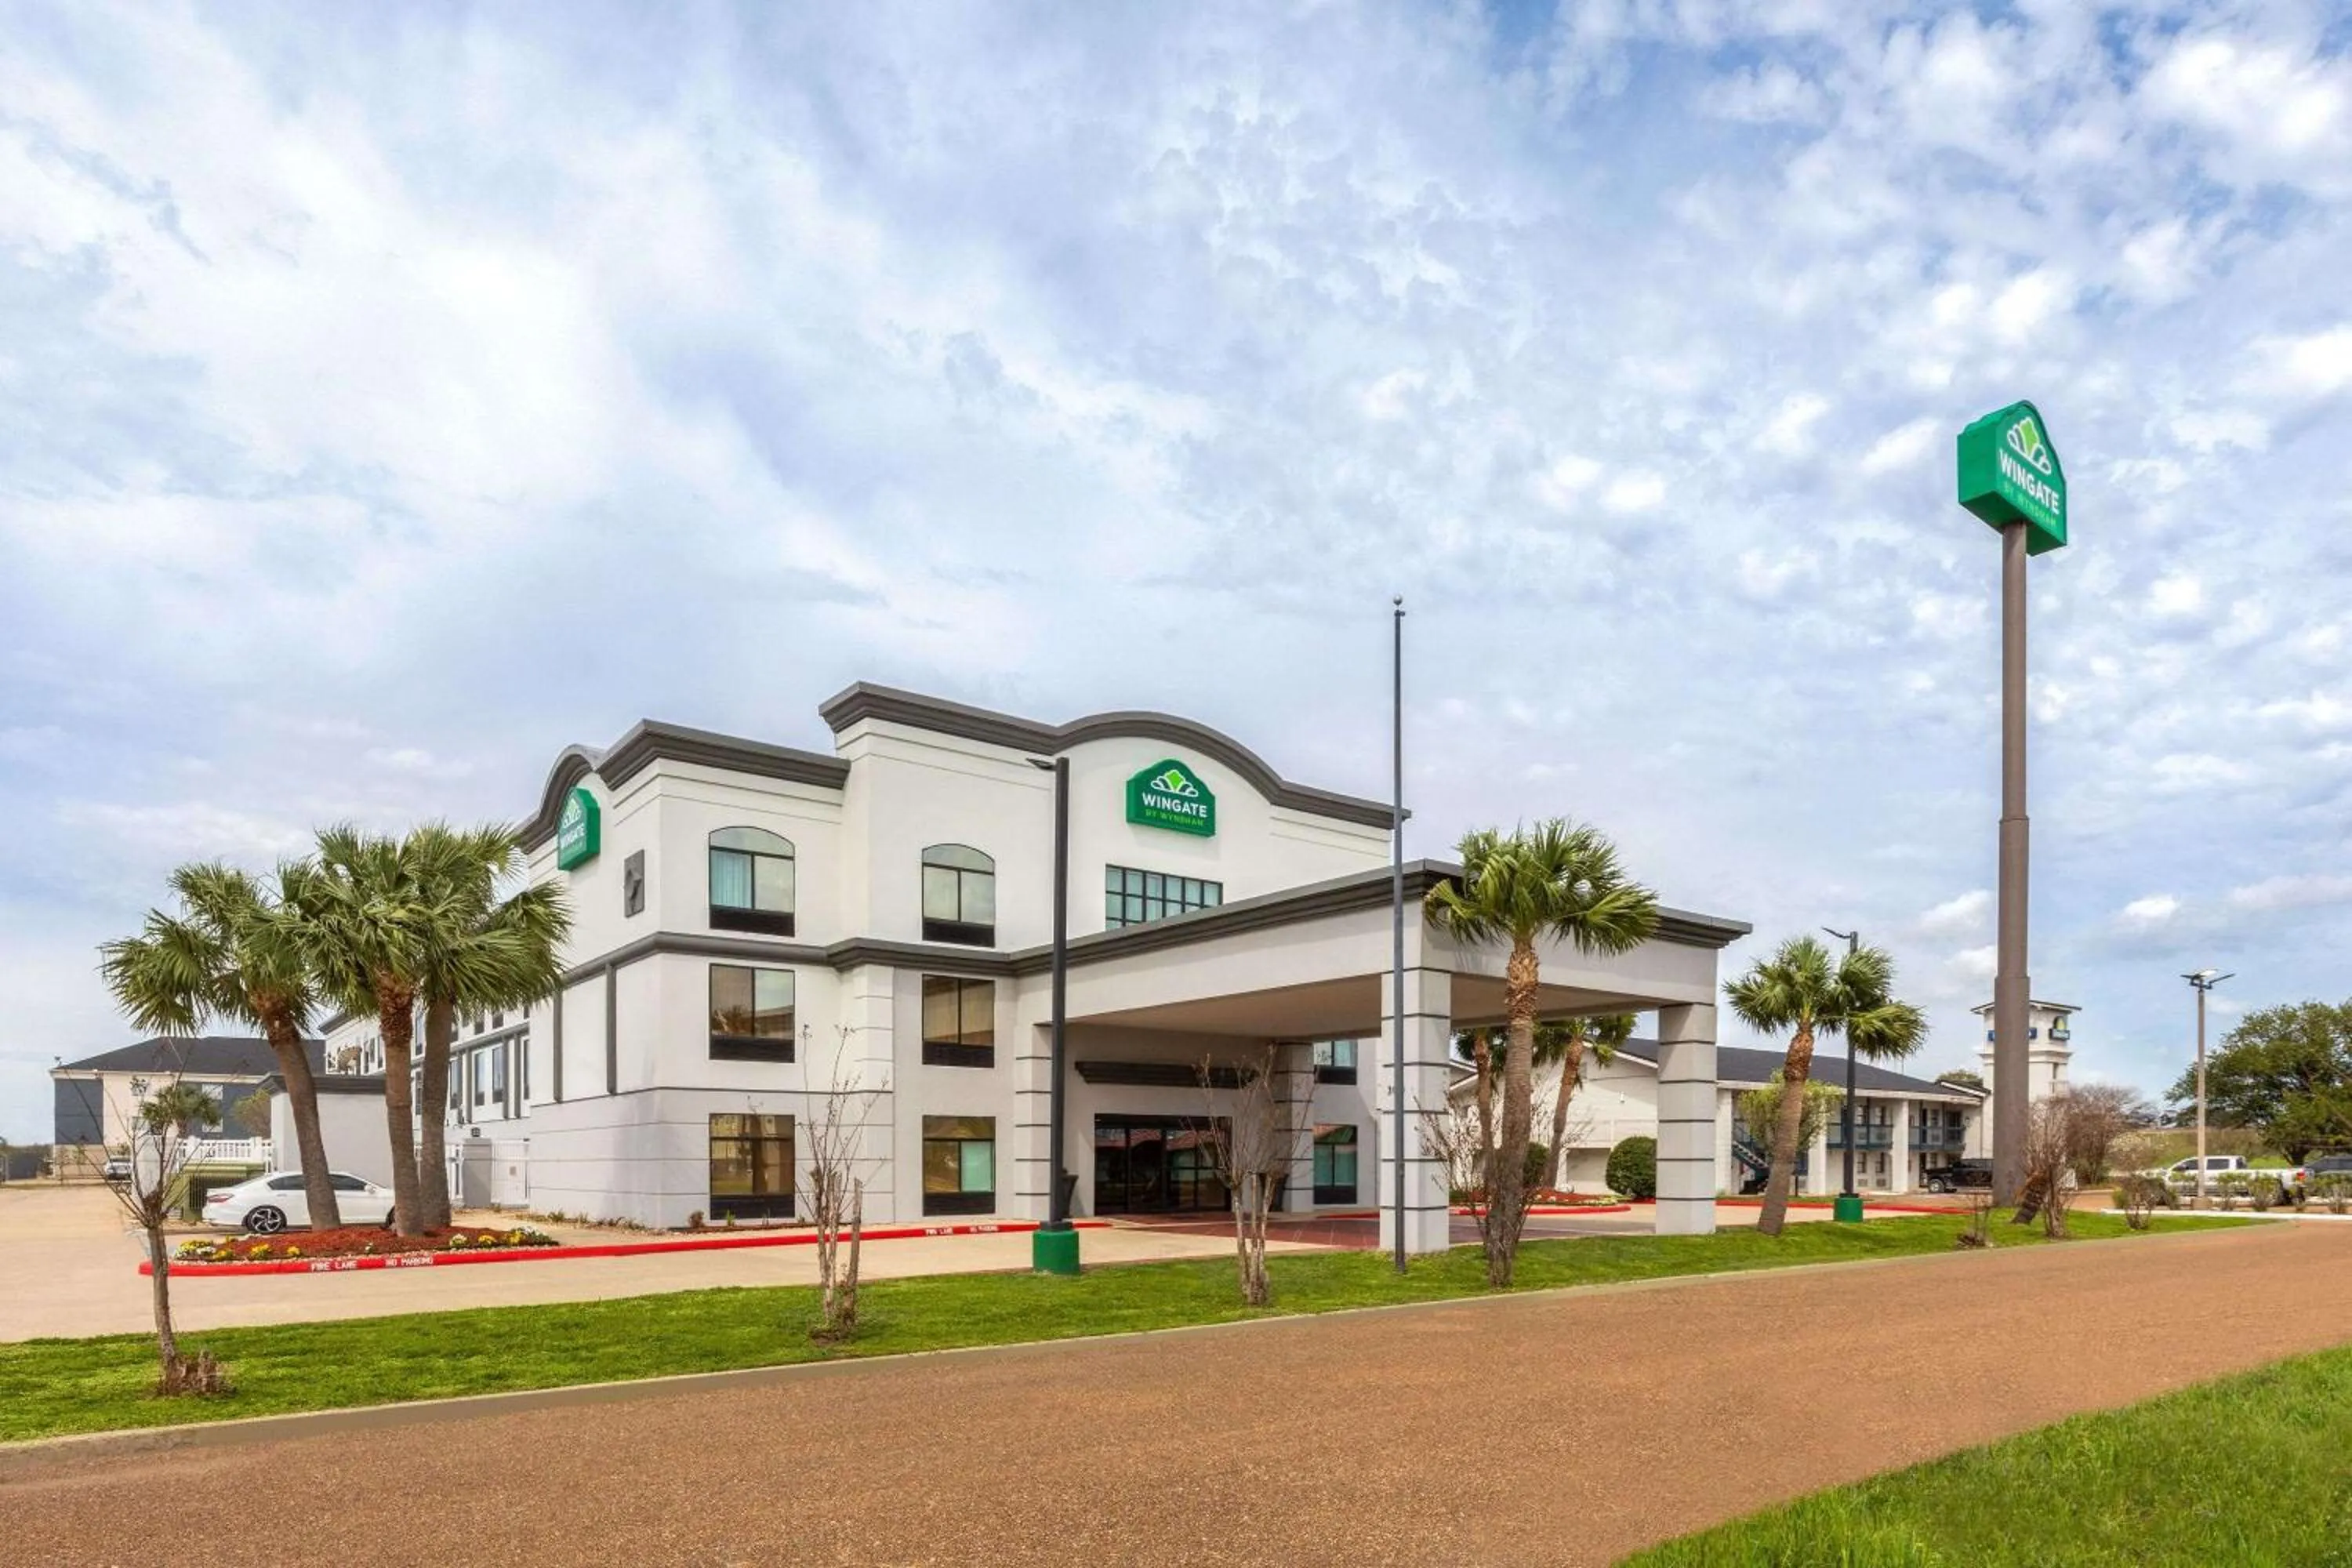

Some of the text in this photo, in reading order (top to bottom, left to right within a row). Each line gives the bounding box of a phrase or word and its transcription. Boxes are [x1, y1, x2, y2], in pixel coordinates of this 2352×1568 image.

[1999, 448, 2060, 515] WINGATE
[1142, 792, 1208, 818] WINGATE
[310, 1261, 330, 1272] FIRE
[335, 1260, 358, 1270] LANE
[385, 1258, 397, 1266] NO
